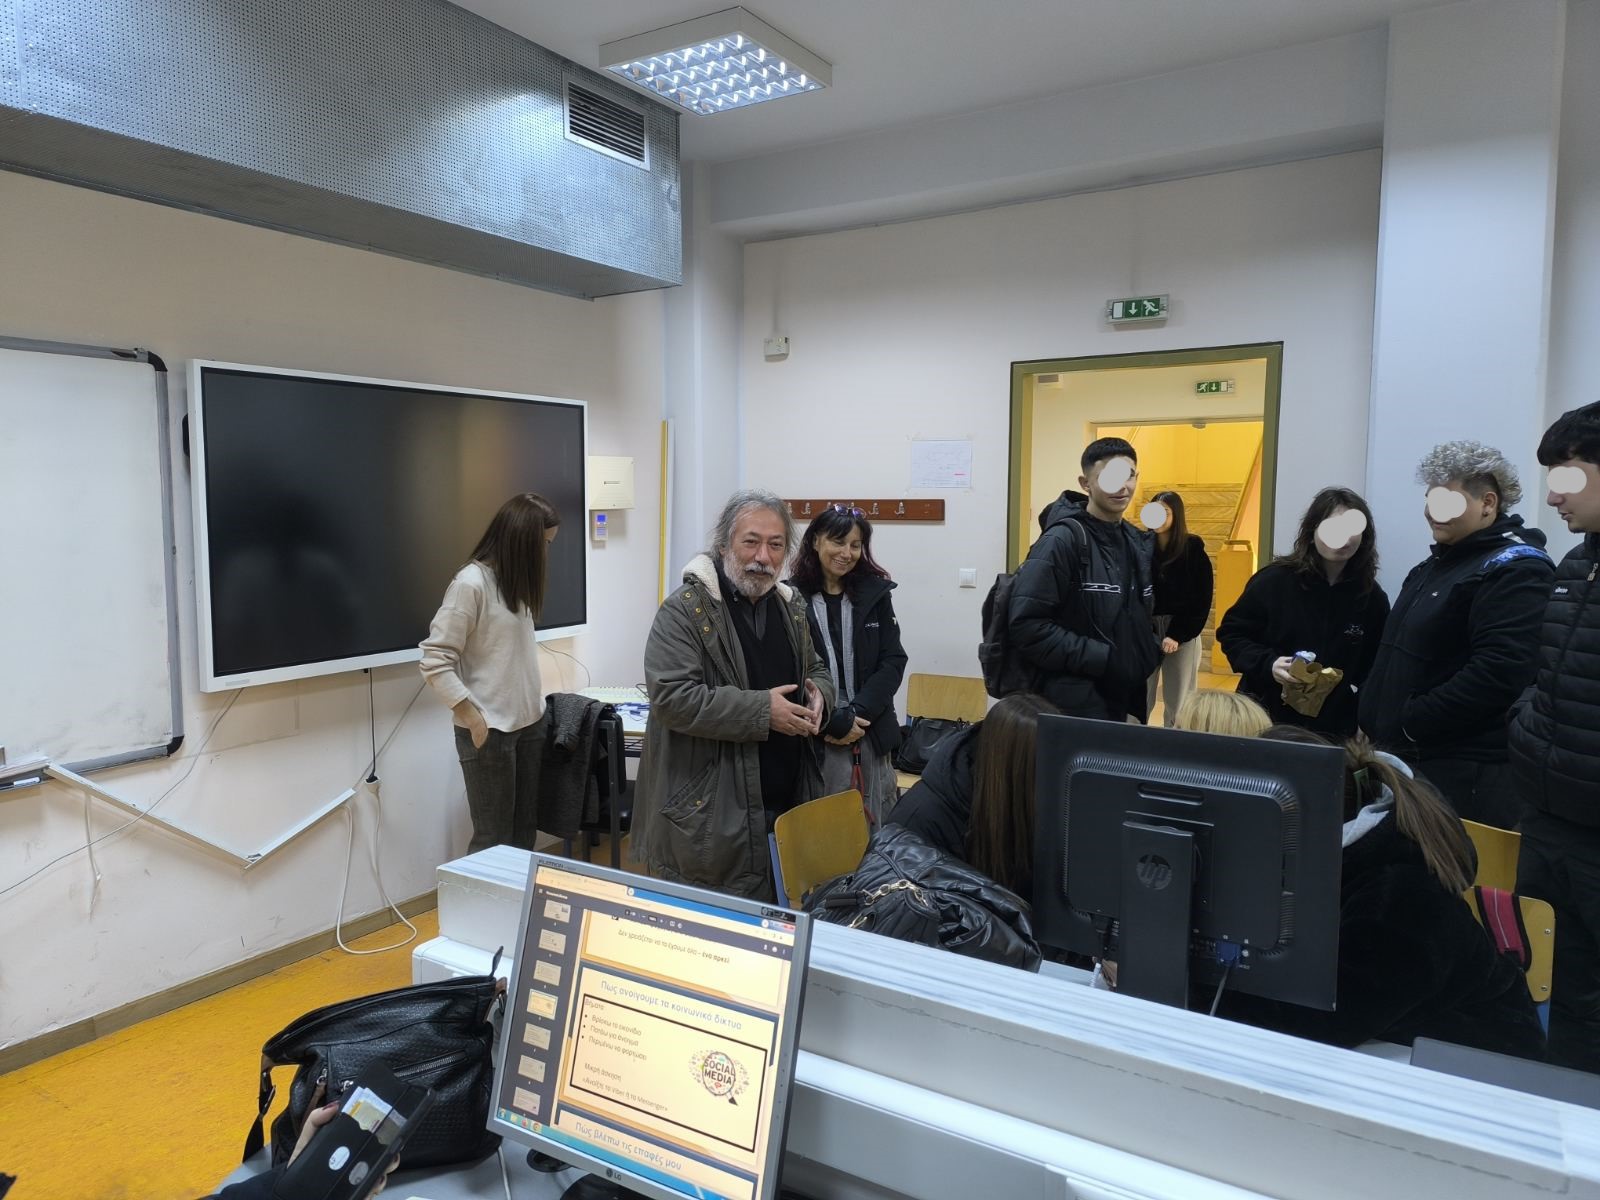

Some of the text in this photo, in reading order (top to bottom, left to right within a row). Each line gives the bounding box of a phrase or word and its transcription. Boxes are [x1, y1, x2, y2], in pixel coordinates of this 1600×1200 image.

[1138, 854, 1170, 890] hp
[661, 1000, 670, 1009] τα
[704, 1058, 736, 1076] SOCIAL
[704, 1068, 732, 1085] MEDIA
[622, 1141, 632, 1154] τις
[666, 1159, 682, 1170] μου
[614, 1172, 622, 1180] LG
